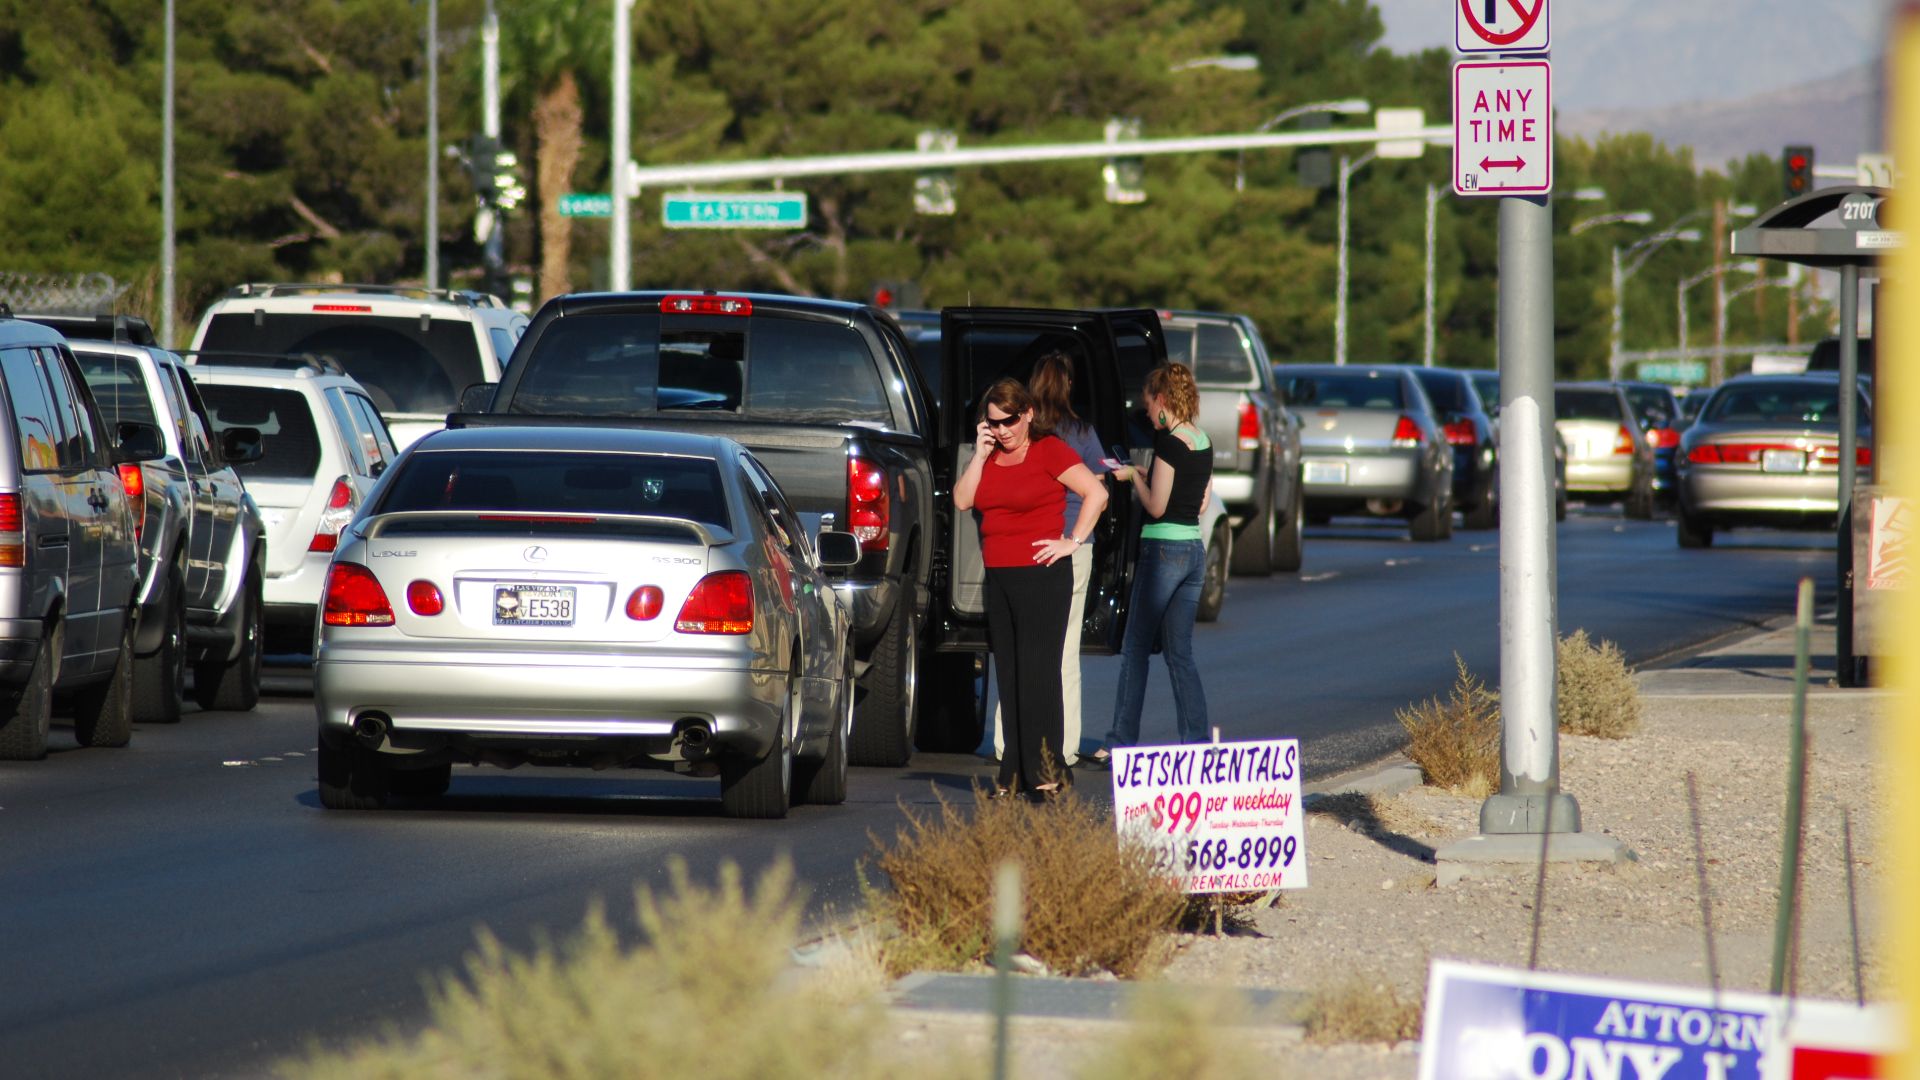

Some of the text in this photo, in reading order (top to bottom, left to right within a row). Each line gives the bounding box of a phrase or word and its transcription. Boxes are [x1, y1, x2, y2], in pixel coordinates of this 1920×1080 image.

[1473, 88, 1533, 113] ANY
[1469, 118, 1536, 143] TIME
[1465, 173, 1479, 189] EW
[689, 203, 779, 221] EASTERN
[1843, 201, 1875, 220] 2707
[371, 550, 417, 558] LEXUS
[673, 557, 702, 566] 300
[529, 599, 570, 618] E538
[1117, 745, 1297, 788] JETSKI RENTALS
[1124, 787, 1292, 835] from $99 per weekday
[1184, 835, 1297, 871] 568-8999
